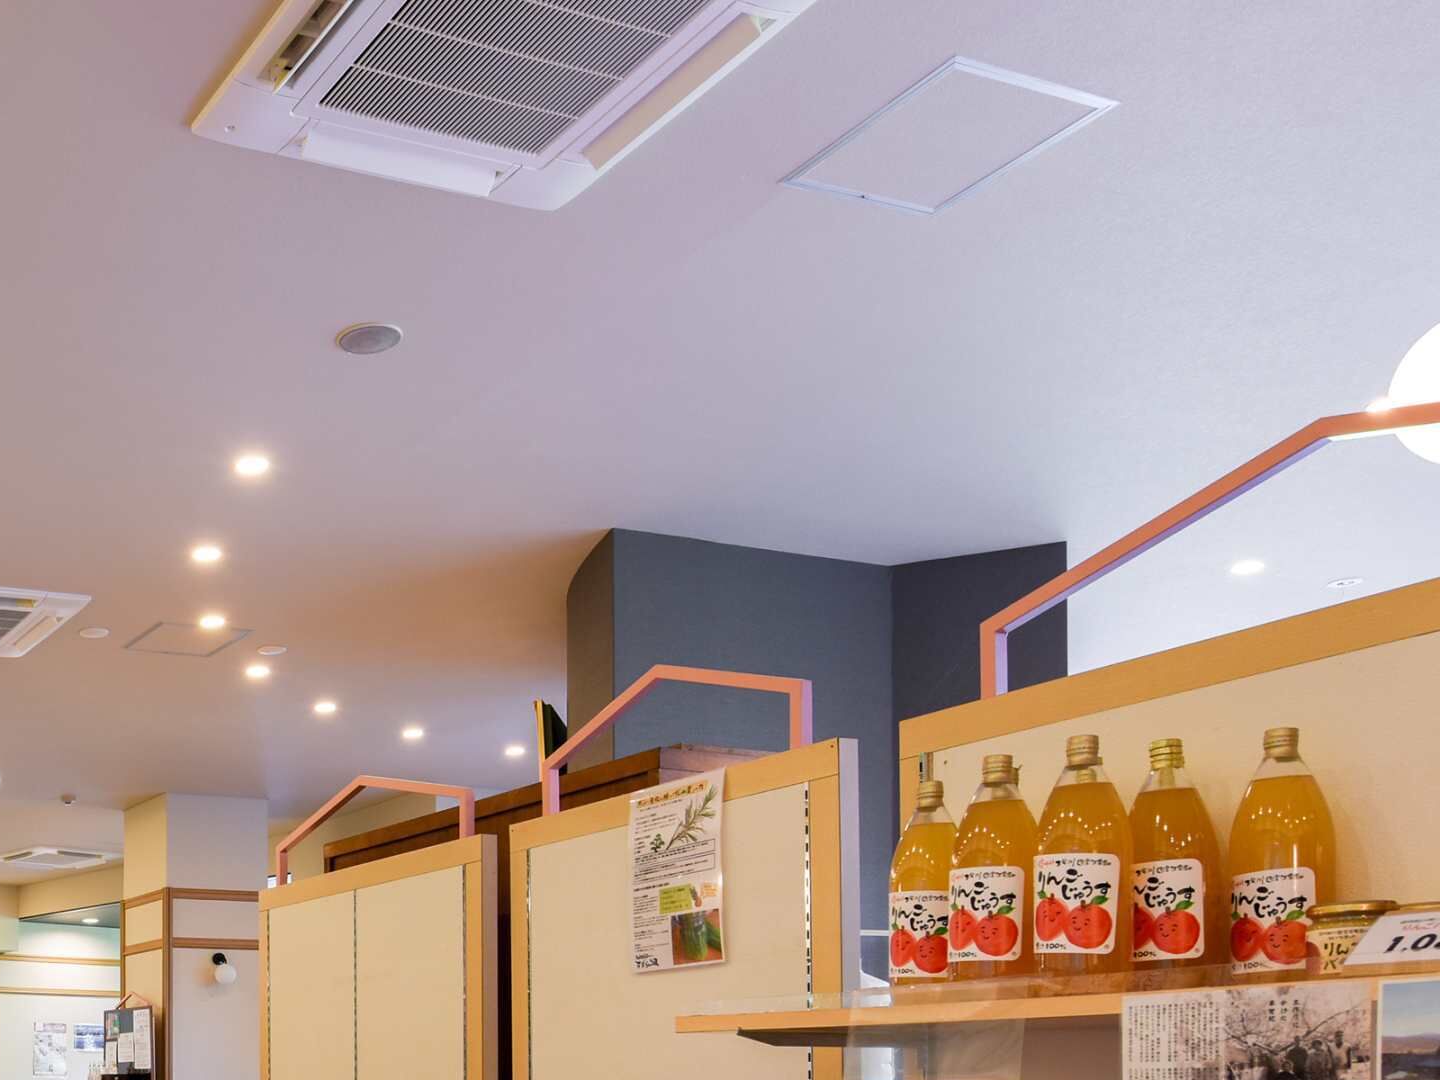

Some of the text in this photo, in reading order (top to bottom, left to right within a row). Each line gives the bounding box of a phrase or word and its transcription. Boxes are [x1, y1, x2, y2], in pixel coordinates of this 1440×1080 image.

[1038, 868, 1083, 892] りんご
[1061, 881, 1111, 901] じゅうす
[952, 881, 989, 906] りんご
[970, 892, 1017, 911] じゅうす
[1144, 886, 1195, 908] じゅうす
[1253, 895, 1308, 918] じゅうす
